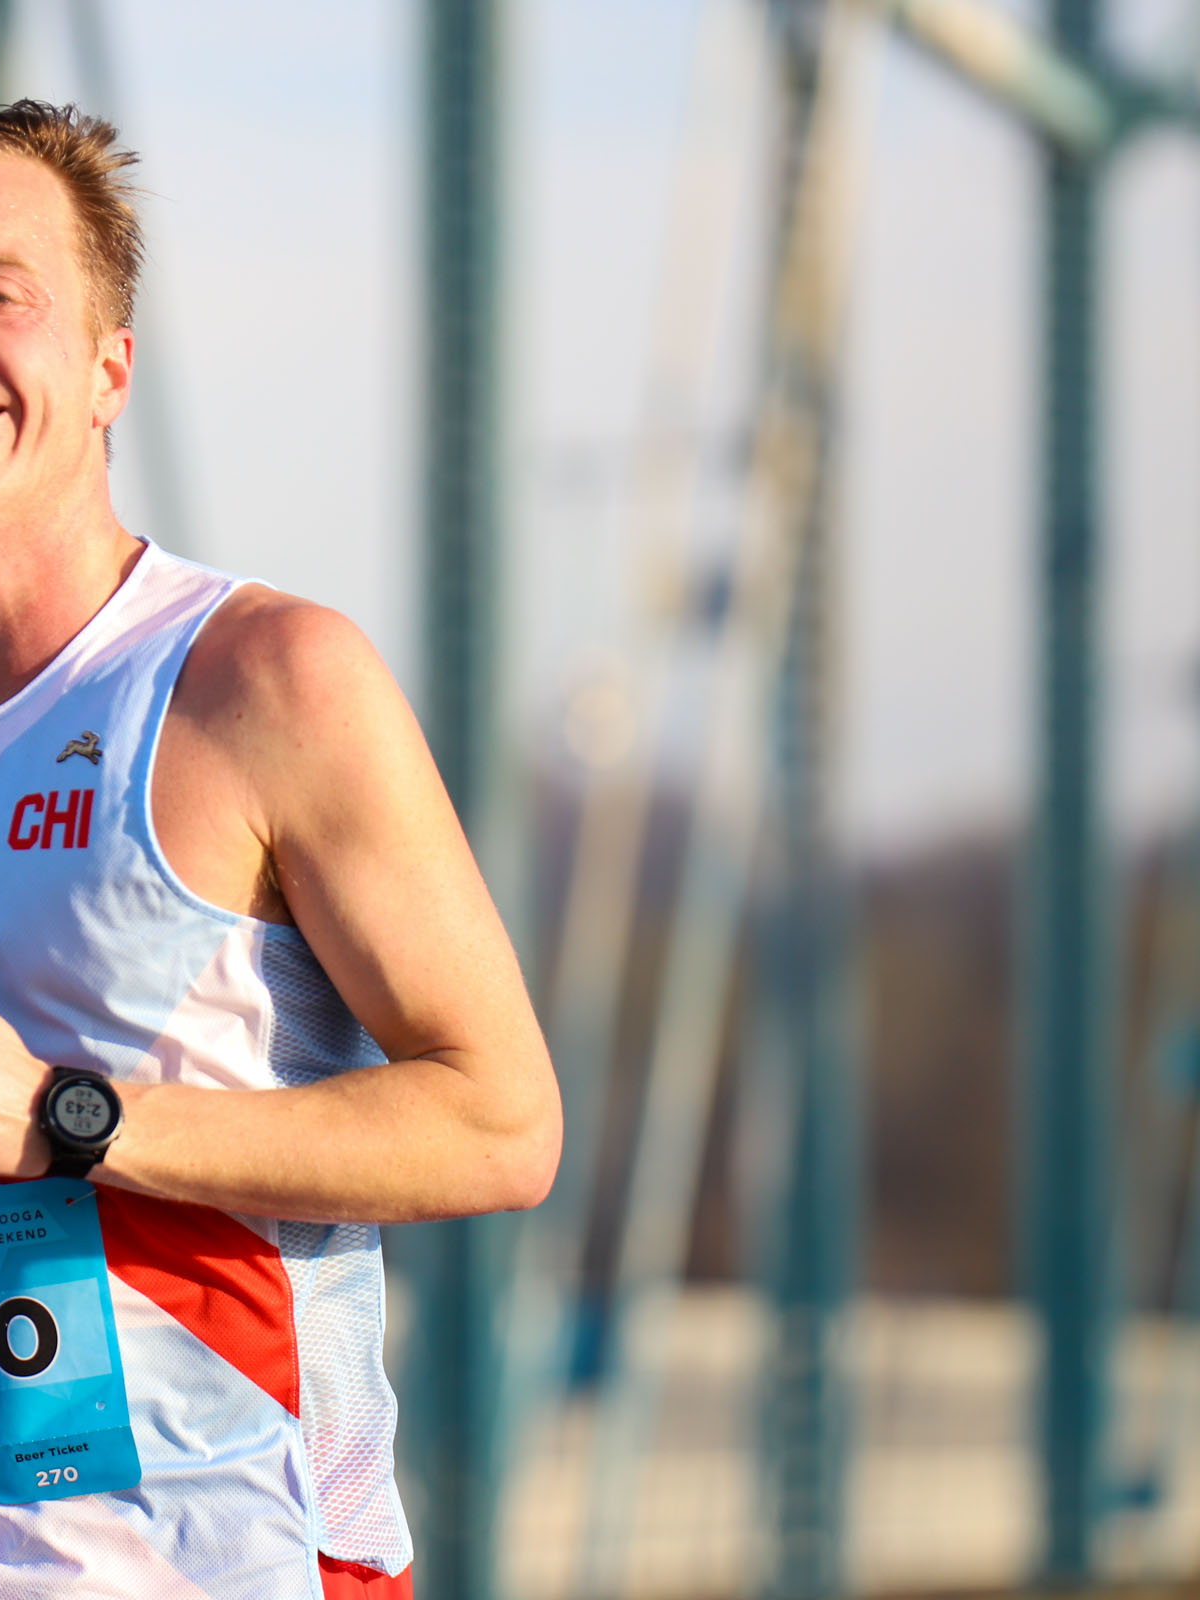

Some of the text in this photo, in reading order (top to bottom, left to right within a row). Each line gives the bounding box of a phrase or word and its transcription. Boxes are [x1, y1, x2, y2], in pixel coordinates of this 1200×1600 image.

[7, 788, 95, 850] CHI
[65, 1100, 101, 1118] 2:43
[14, 1442, 89, 1463] Beer Ticket
[35, 1466, 79, 1488] 270
